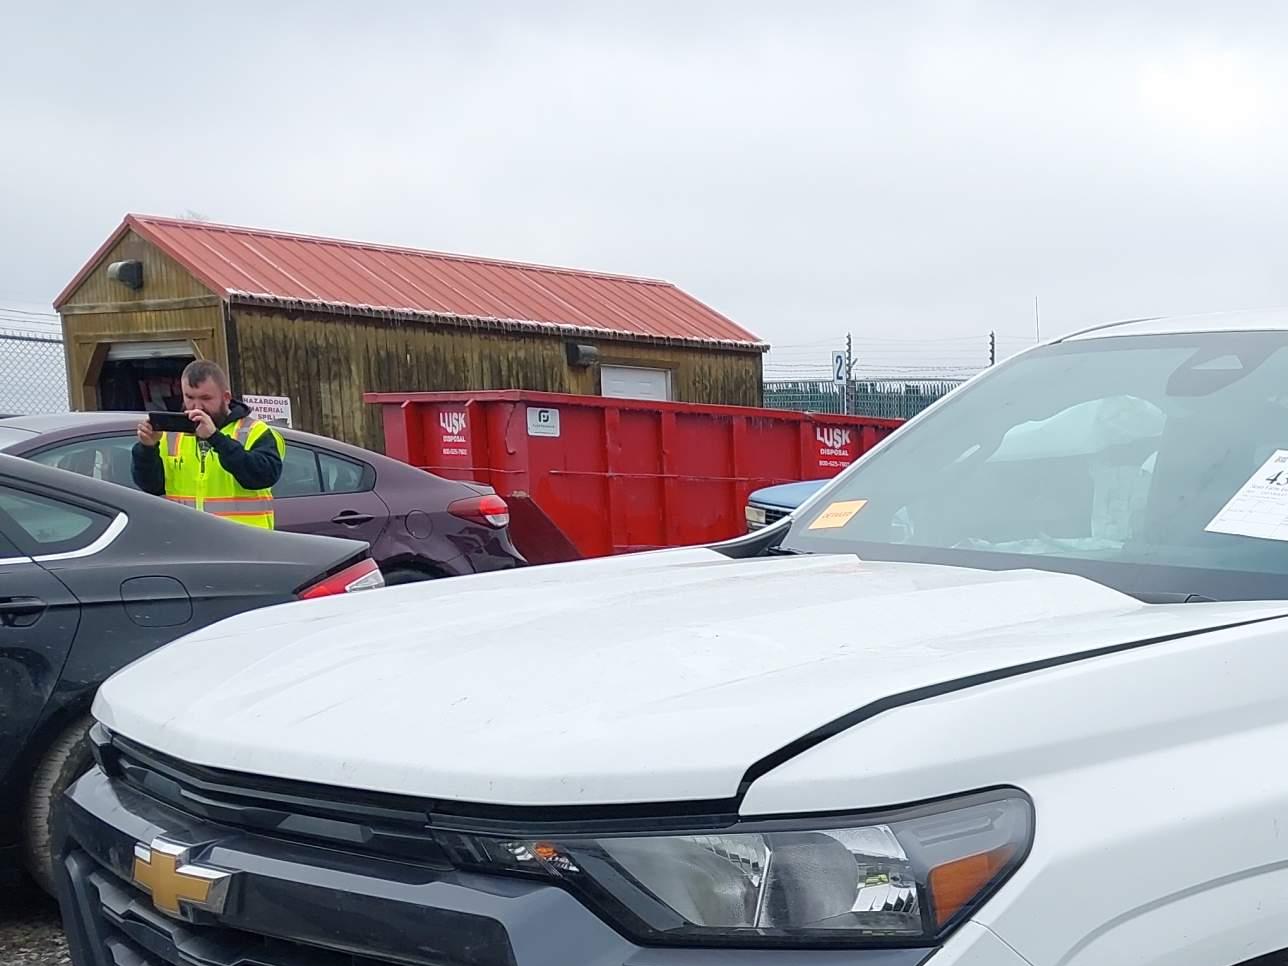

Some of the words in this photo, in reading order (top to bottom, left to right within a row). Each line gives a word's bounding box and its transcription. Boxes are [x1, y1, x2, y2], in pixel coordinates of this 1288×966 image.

[835, 355, 843, 380] 2
[440, 412, 466, 435] LUSK
[816, 427, 850, 448] LUSK
[820, 448, 849, 456] DISPOSAL
